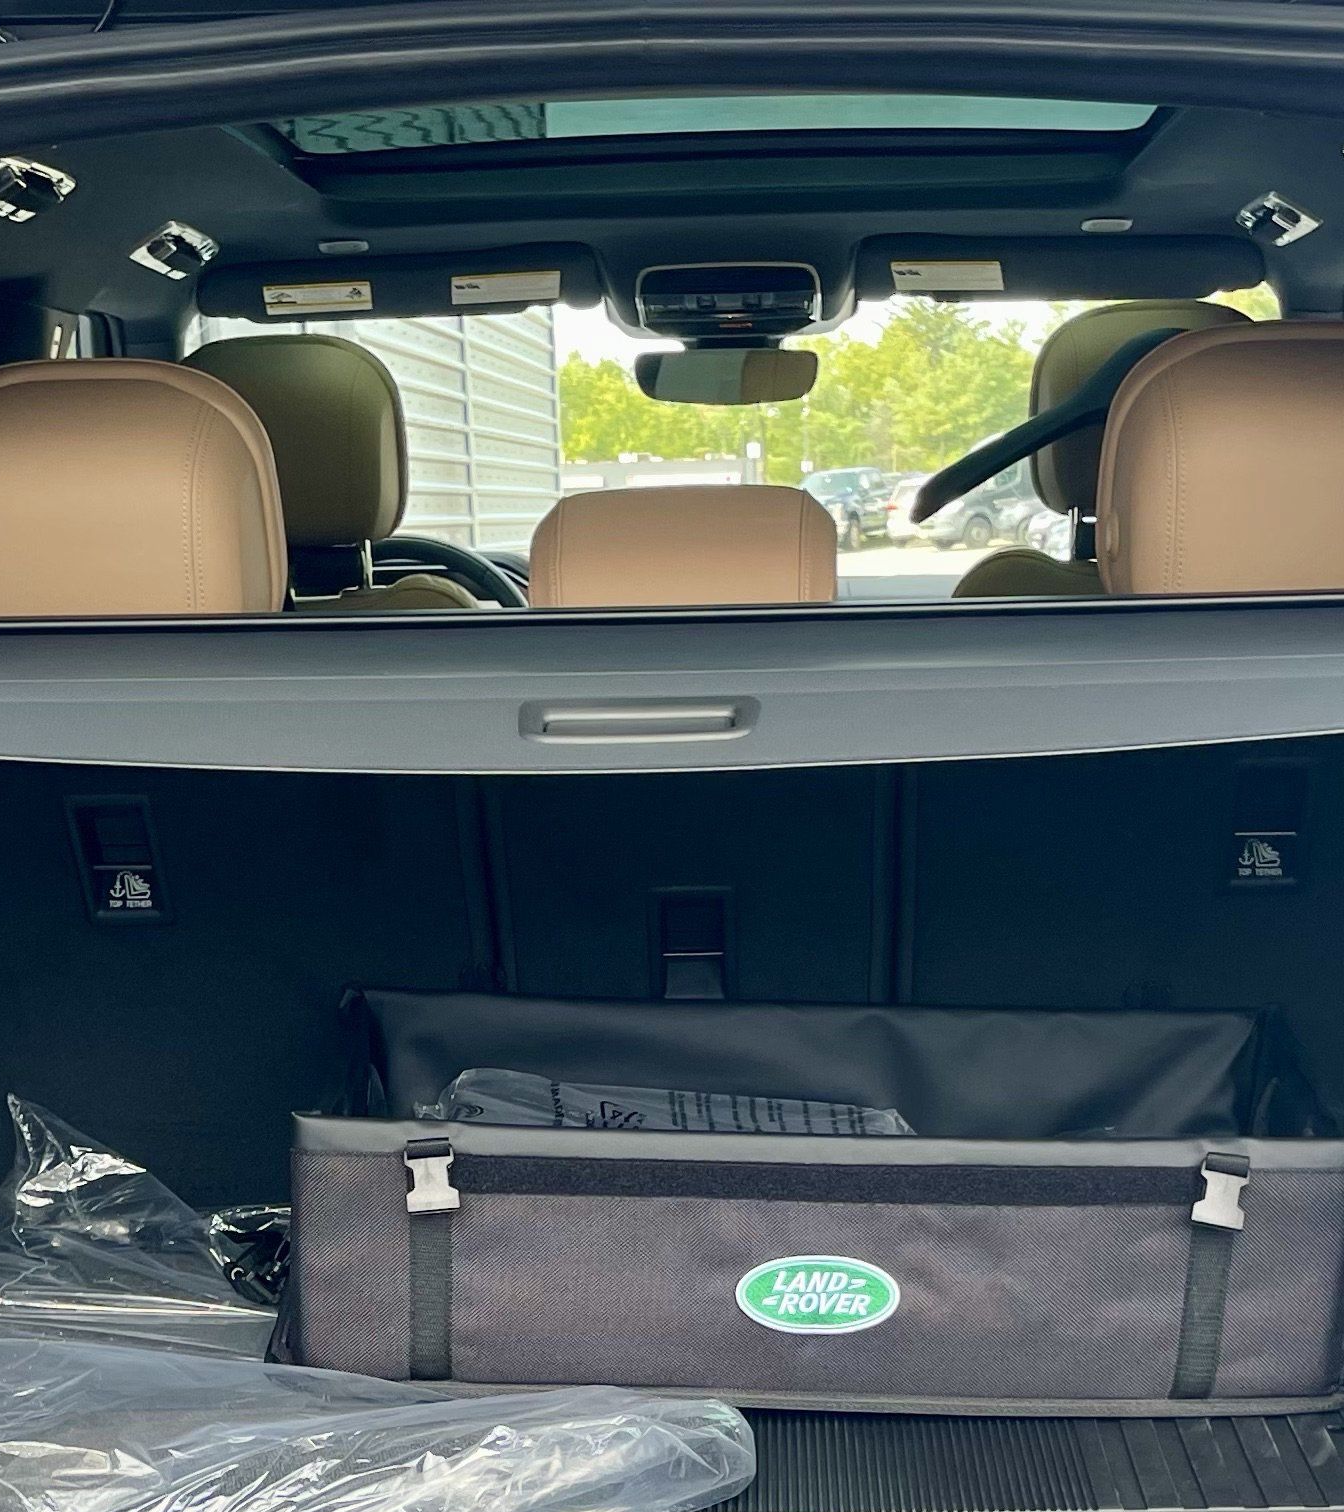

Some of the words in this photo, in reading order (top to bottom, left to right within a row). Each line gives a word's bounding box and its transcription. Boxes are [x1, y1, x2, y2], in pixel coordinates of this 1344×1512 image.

[109, 899, 123, 908] TOP
[126, 899, 152, 908] TETHER
[772, 1271, 850, 1293] LAND
[777, 1292, 871, 1315] ROVER
